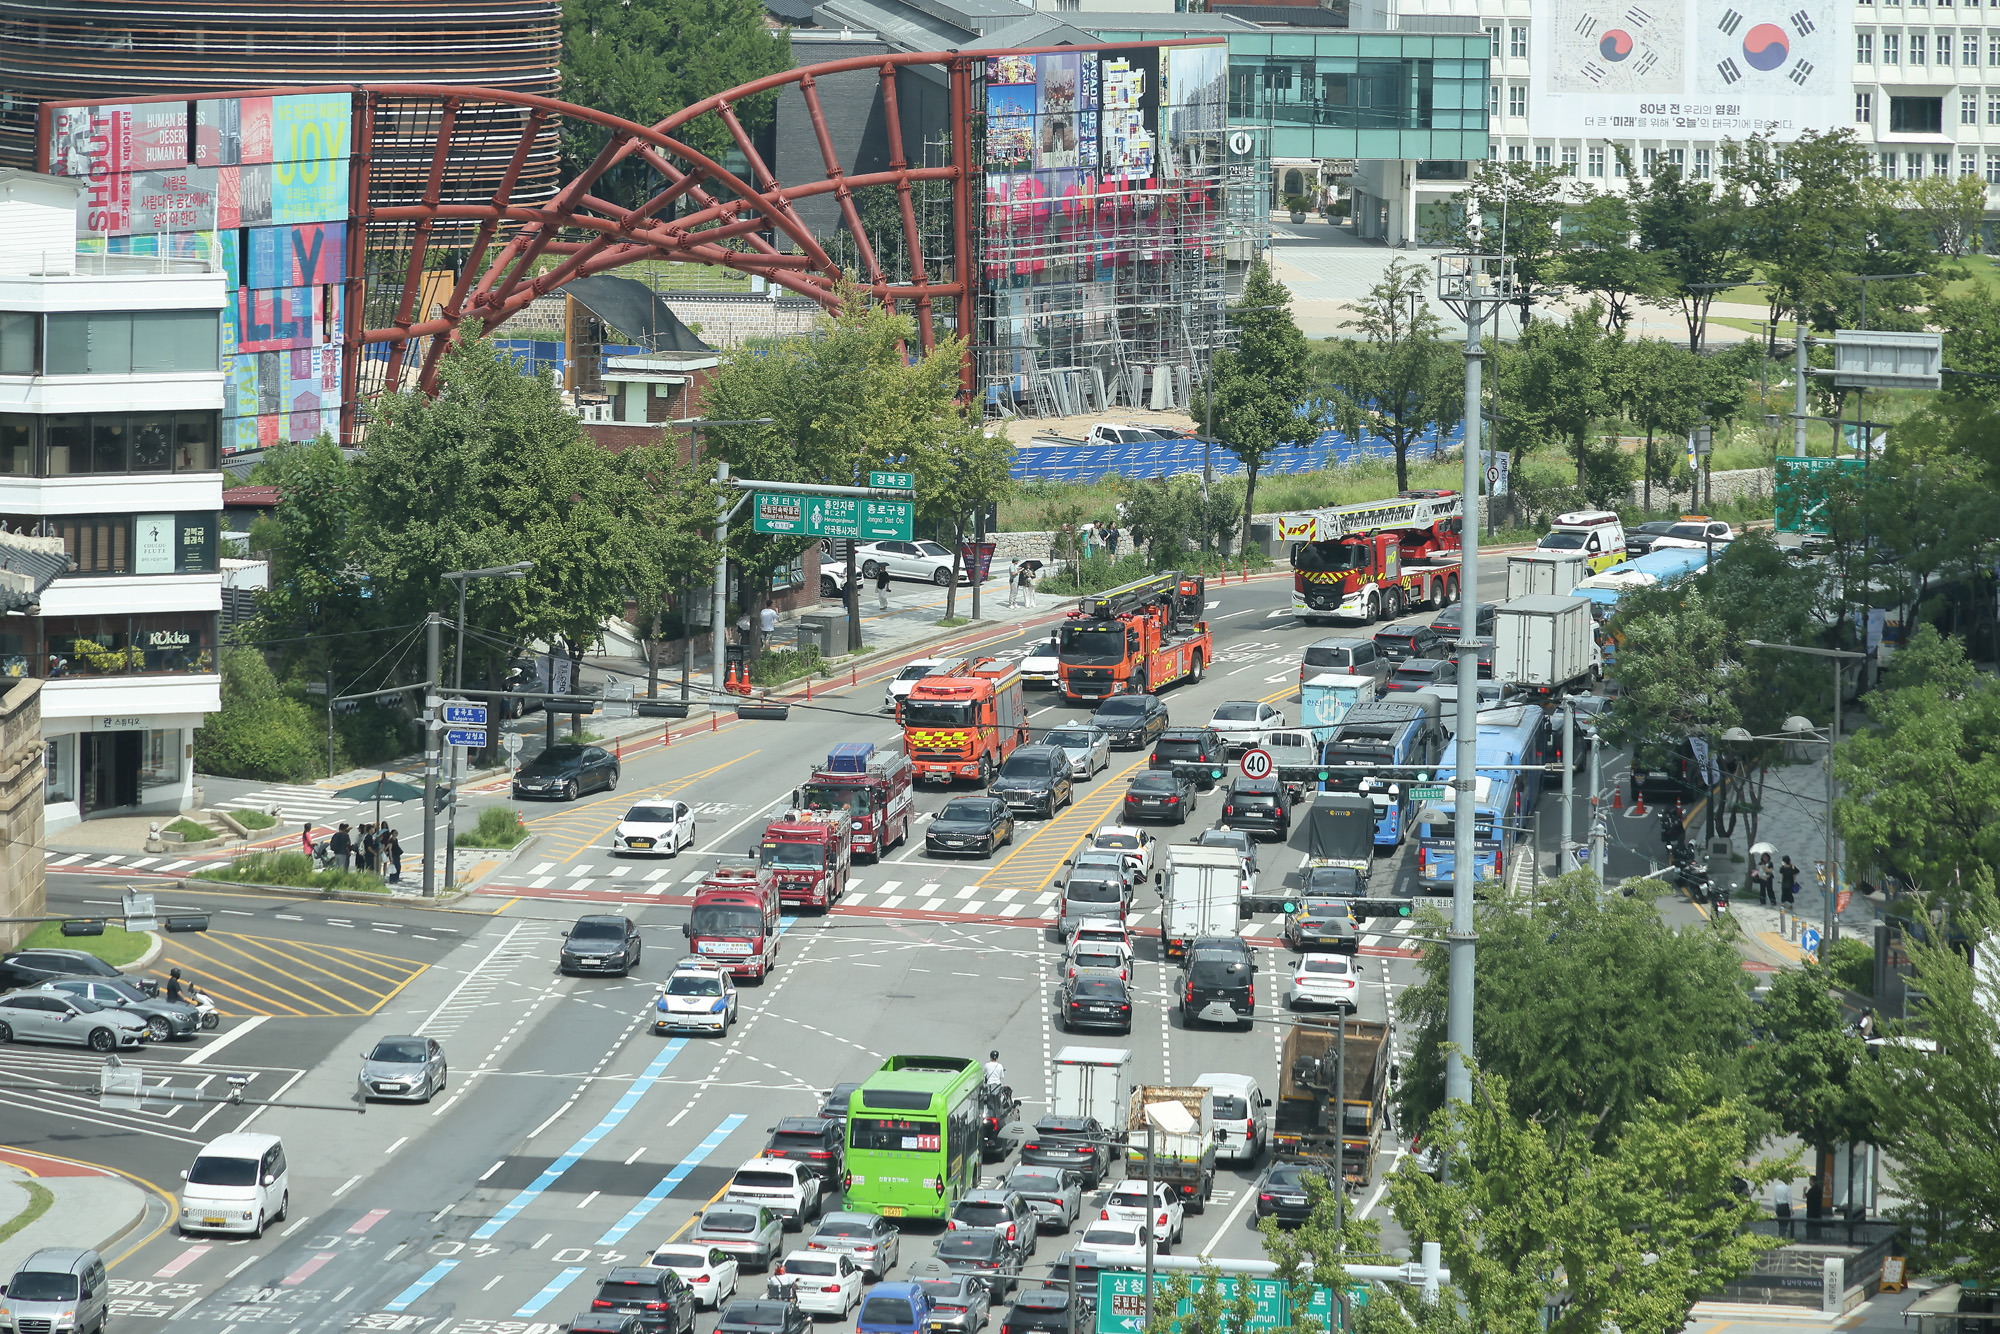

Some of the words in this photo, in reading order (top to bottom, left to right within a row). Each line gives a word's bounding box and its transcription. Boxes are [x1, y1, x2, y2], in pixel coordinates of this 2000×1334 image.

[1089, 52, 1098, 105] FACADE
[277, 104, 292, 121] WE
[294, 103, 316, 119] NEED
[320, 101, 347, 118] MORE
[1639, 103, 1666, 115] 80년
[1669, 103, 1681, 115] 전
[1683, 104, 1712, 115] 우리의
[1715, 104, 1741, 116] 염원!
[147, 113, 176, 129] HUMAN
[177, 111, 206, 127] BEGS
[1584, 116, 1594, 126] 더
[1597, 117, 1607, 127] 큰
[1650, 117, 1669, 128] 위해
[1712, 118, 1750, 129] 태극기에
[146, 146, 175, 163] HUMAN
[177, 144, 207, 161] PLES
[276, 121, 346, 186] JOY
[87, 113, 110, 232] SHOUT
[162, 175, 188, 192] 사람은
[141, 193, 174, 210] 사람다운
[176, 191, 210, 209] 공간에서
[180, 210, 198, 226] 한다
[312, 347, 321, 373] THE
[876, 474, 907, 486] 경복궁
[760, 496, 801, 507] 삼청터널
[824, 499, 856, 511] 흥인지문
[866, 503, 906, 516] 종로구청
[812, 514, 821, 522] 50
[866, 515, 883, 524] Jongno
[823, 525, 858, 537] 안국동사거리
[1286, 523, 1309, 536] 119
[1385, 550, 1397, 565] 119
[465, 732, 484, 741] 삼청로
[1246, 755, 1265, 773] 40
[899, 1121, 910, 1129] 11
[924, 1136, 939, 1148] 11
[550, 1247, 628, 1265] 40
[1113, 1307, 1137, 1315] National
